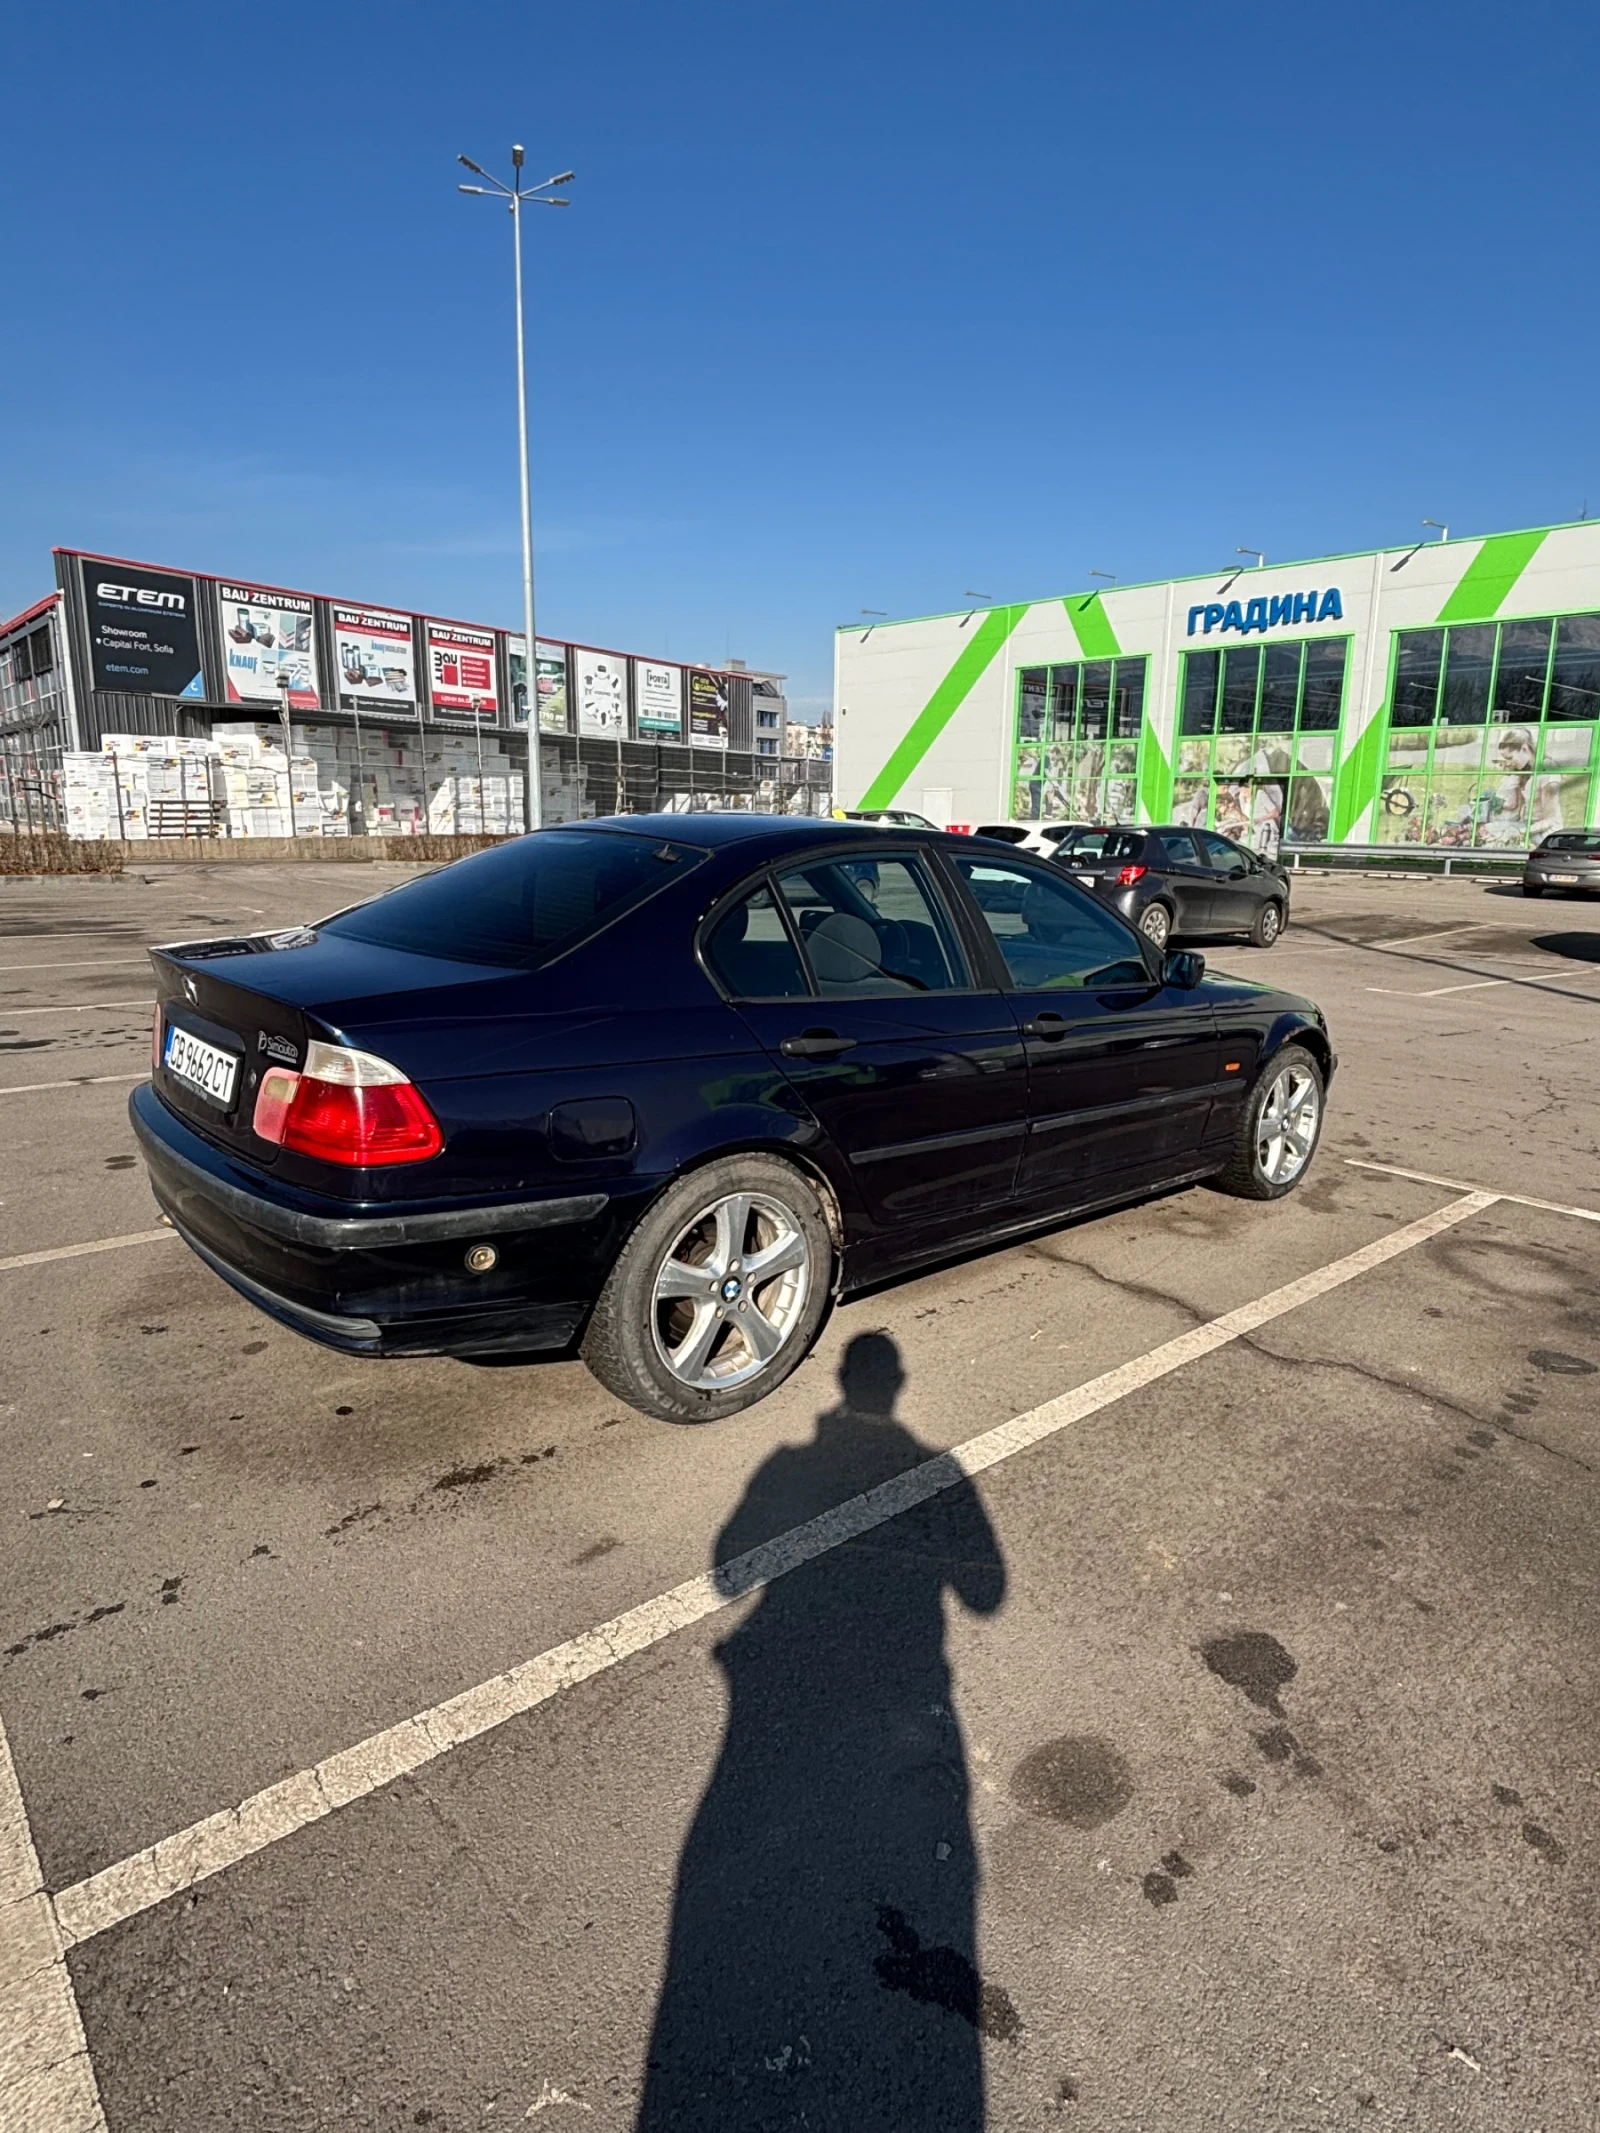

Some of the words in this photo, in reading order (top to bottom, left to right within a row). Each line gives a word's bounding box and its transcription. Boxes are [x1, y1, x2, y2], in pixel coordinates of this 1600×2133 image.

[97, 583, 185, 609] ETEM
[222, 587, 249, 602] BAU
[251, 592, 311, 611] ZENTRUM
[1187, 588, 1343, 636] ГРАДИНА
[338, 613, 359, 625] BAU
[361, 618, 408, 632] ZENTRUM
[101, 625, 148, 639] Showroom
[432, 630, 450, 641] BAU
[451, 633, 492, 647] ZENTRUM
[103, 638, 132, 649] Capital
[134, 641, 152, 652] Fort,
[154, 643, 174, 654] Sofia
[106, 664, 149, 675] etem.com
[649, 673, 668, 684] PORTA
[185, 1042, 214, 1088] 9662
[212, 1057, 234, 1097] CT
